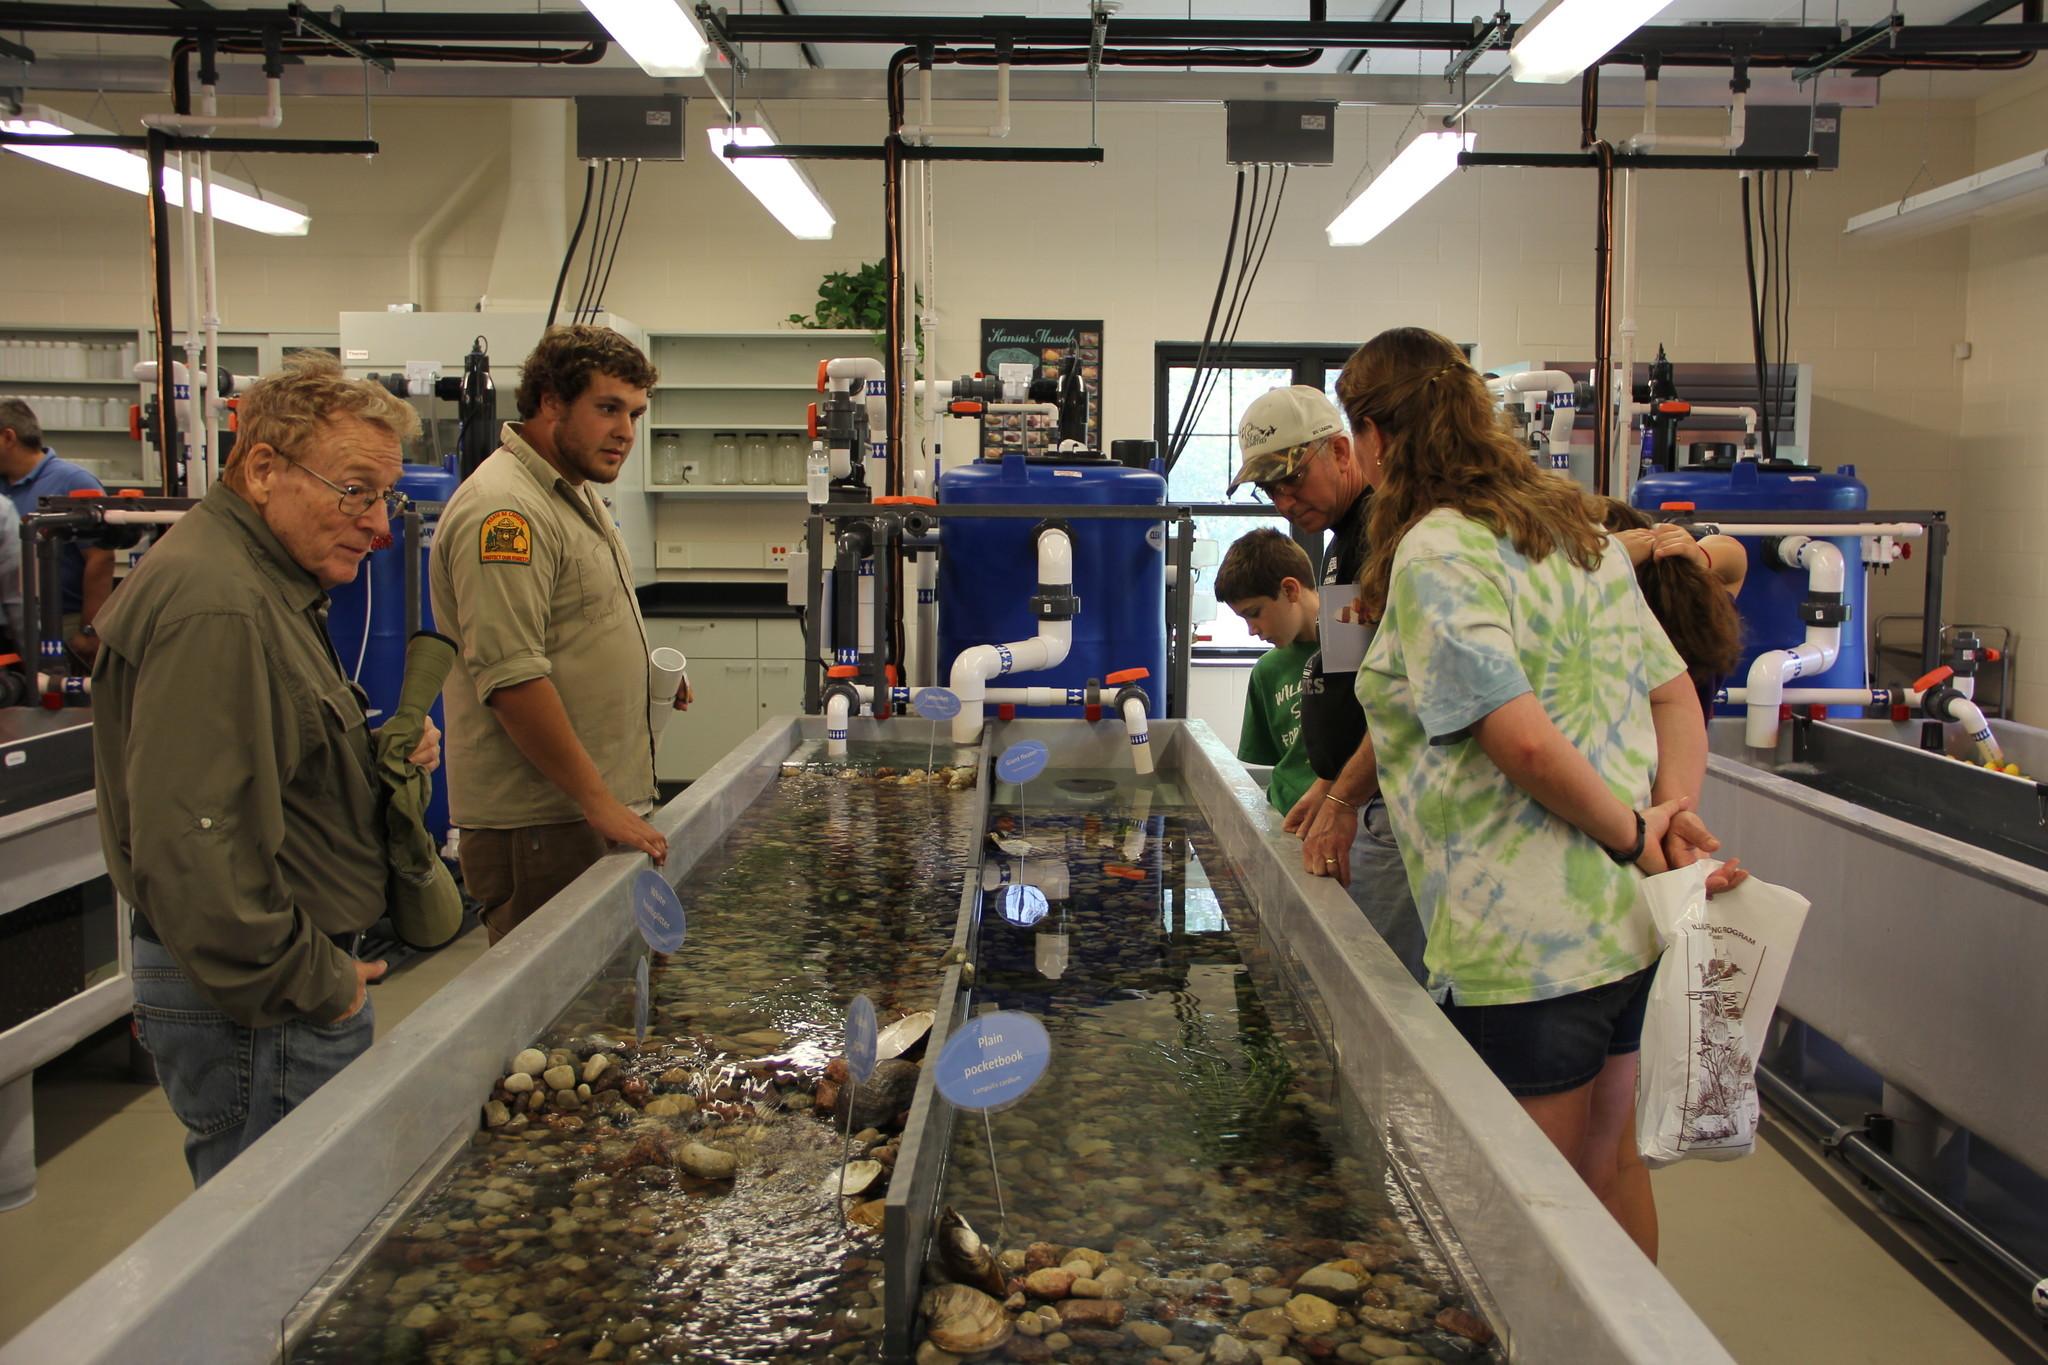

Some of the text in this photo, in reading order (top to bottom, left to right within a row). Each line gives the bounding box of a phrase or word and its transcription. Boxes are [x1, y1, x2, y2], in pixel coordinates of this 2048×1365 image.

[988, 328, 1030, 343] Kansas
[651, 886, 666, 906] White
[977, 1033, 1003, 1048] Plain
[963, 1049, 1024, 1080] pocketbook
